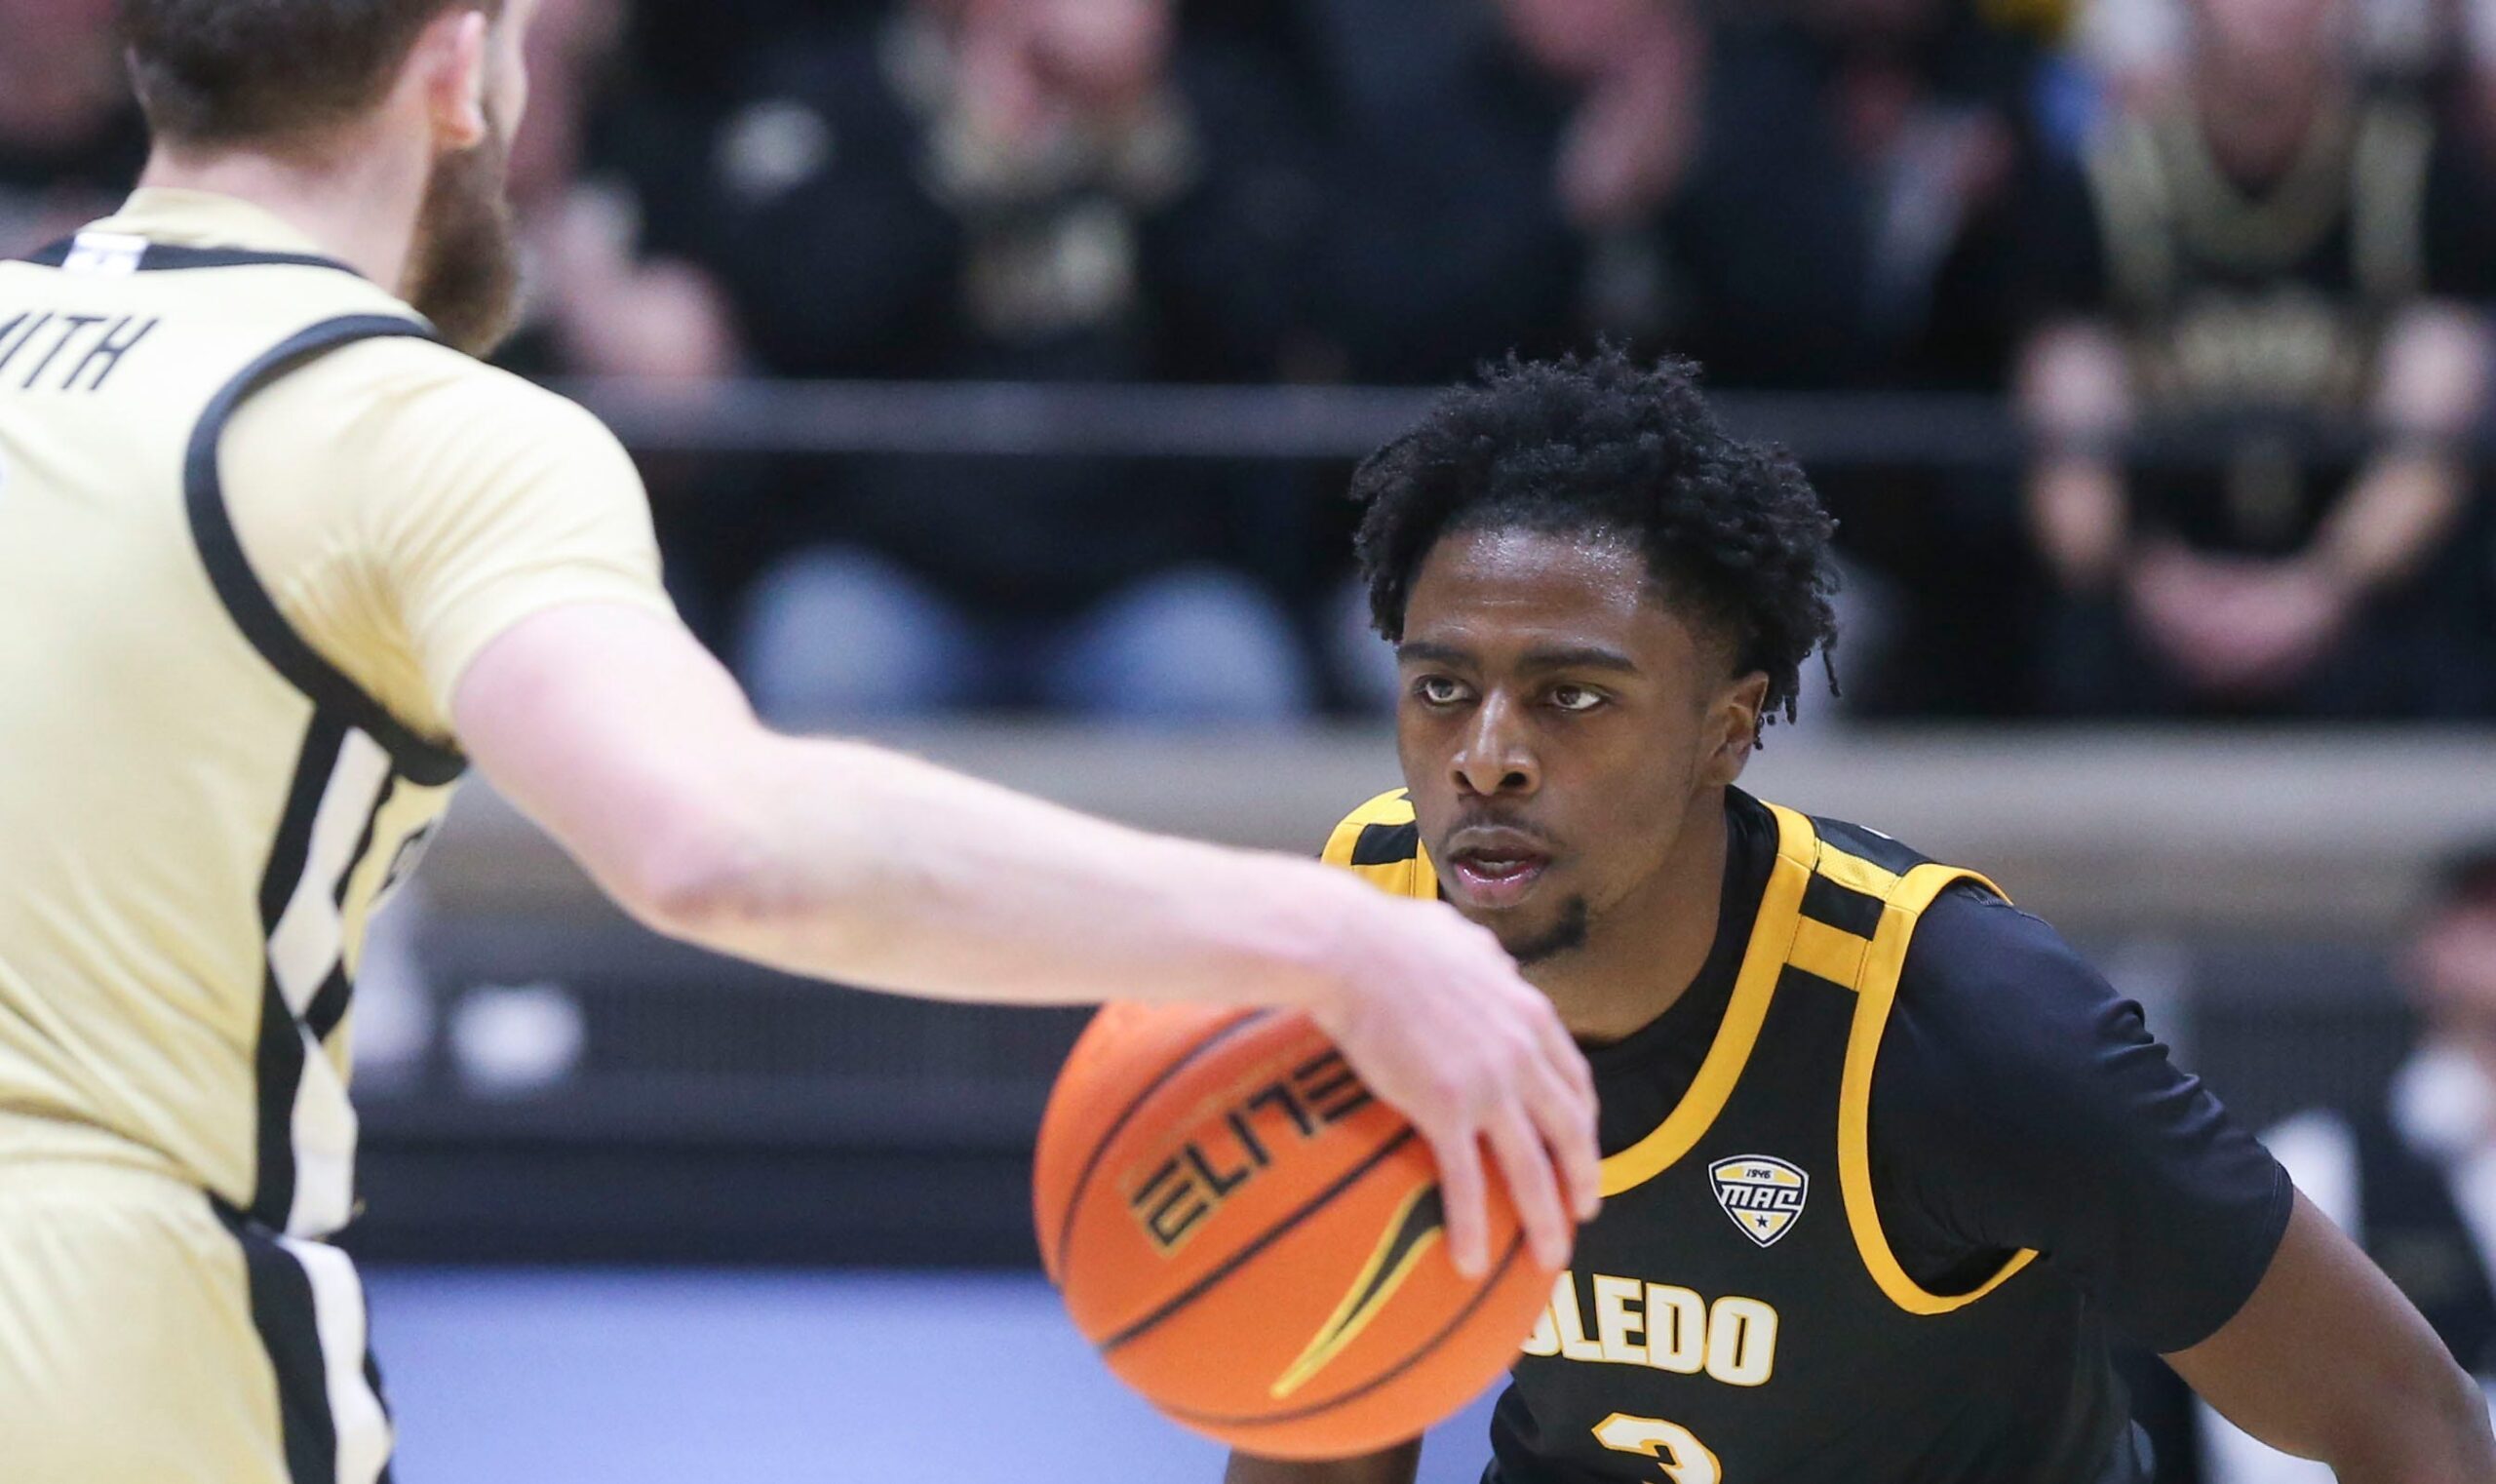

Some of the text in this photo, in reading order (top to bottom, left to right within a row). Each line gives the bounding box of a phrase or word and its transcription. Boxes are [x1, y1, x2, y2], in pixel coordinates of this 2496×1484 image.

[1746, 1169, 1772, 1180] 1946
[1721, 1184, 1802, 1211] MAC
[1520, 1269, 1778, 1386] LEDO
